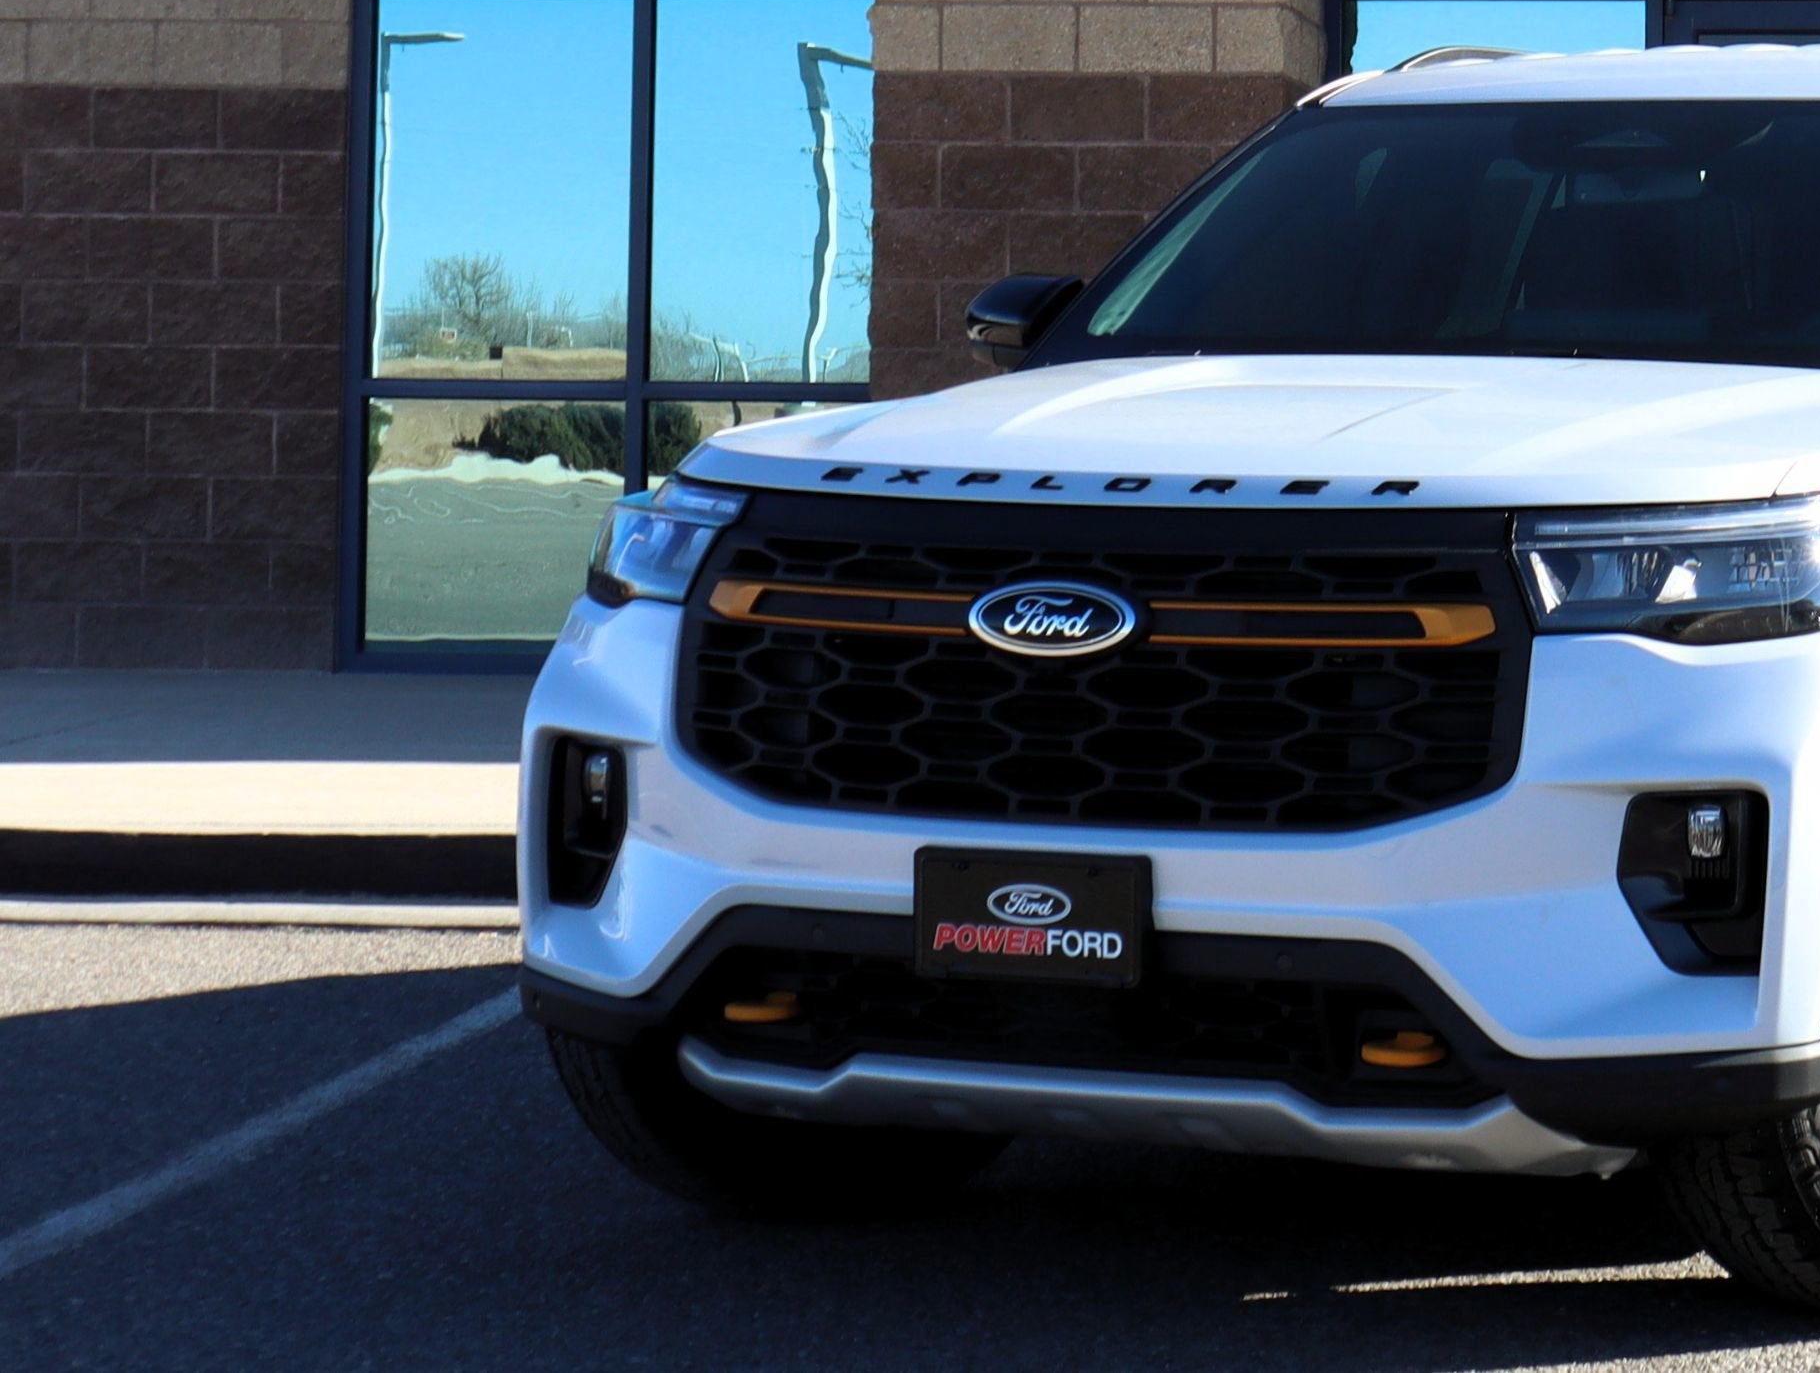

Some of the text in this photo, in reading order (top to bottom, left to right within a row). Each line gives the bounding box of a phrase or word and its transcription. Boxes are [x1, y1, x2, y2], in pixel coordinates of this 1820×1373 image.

[820, 466, 1421, 497] EXPLORER
[1003, 594, 1094, 638] Ford
[1003, 891, 1057, 917] Ford
[933, 922, 1124, 960] POWERFORD
